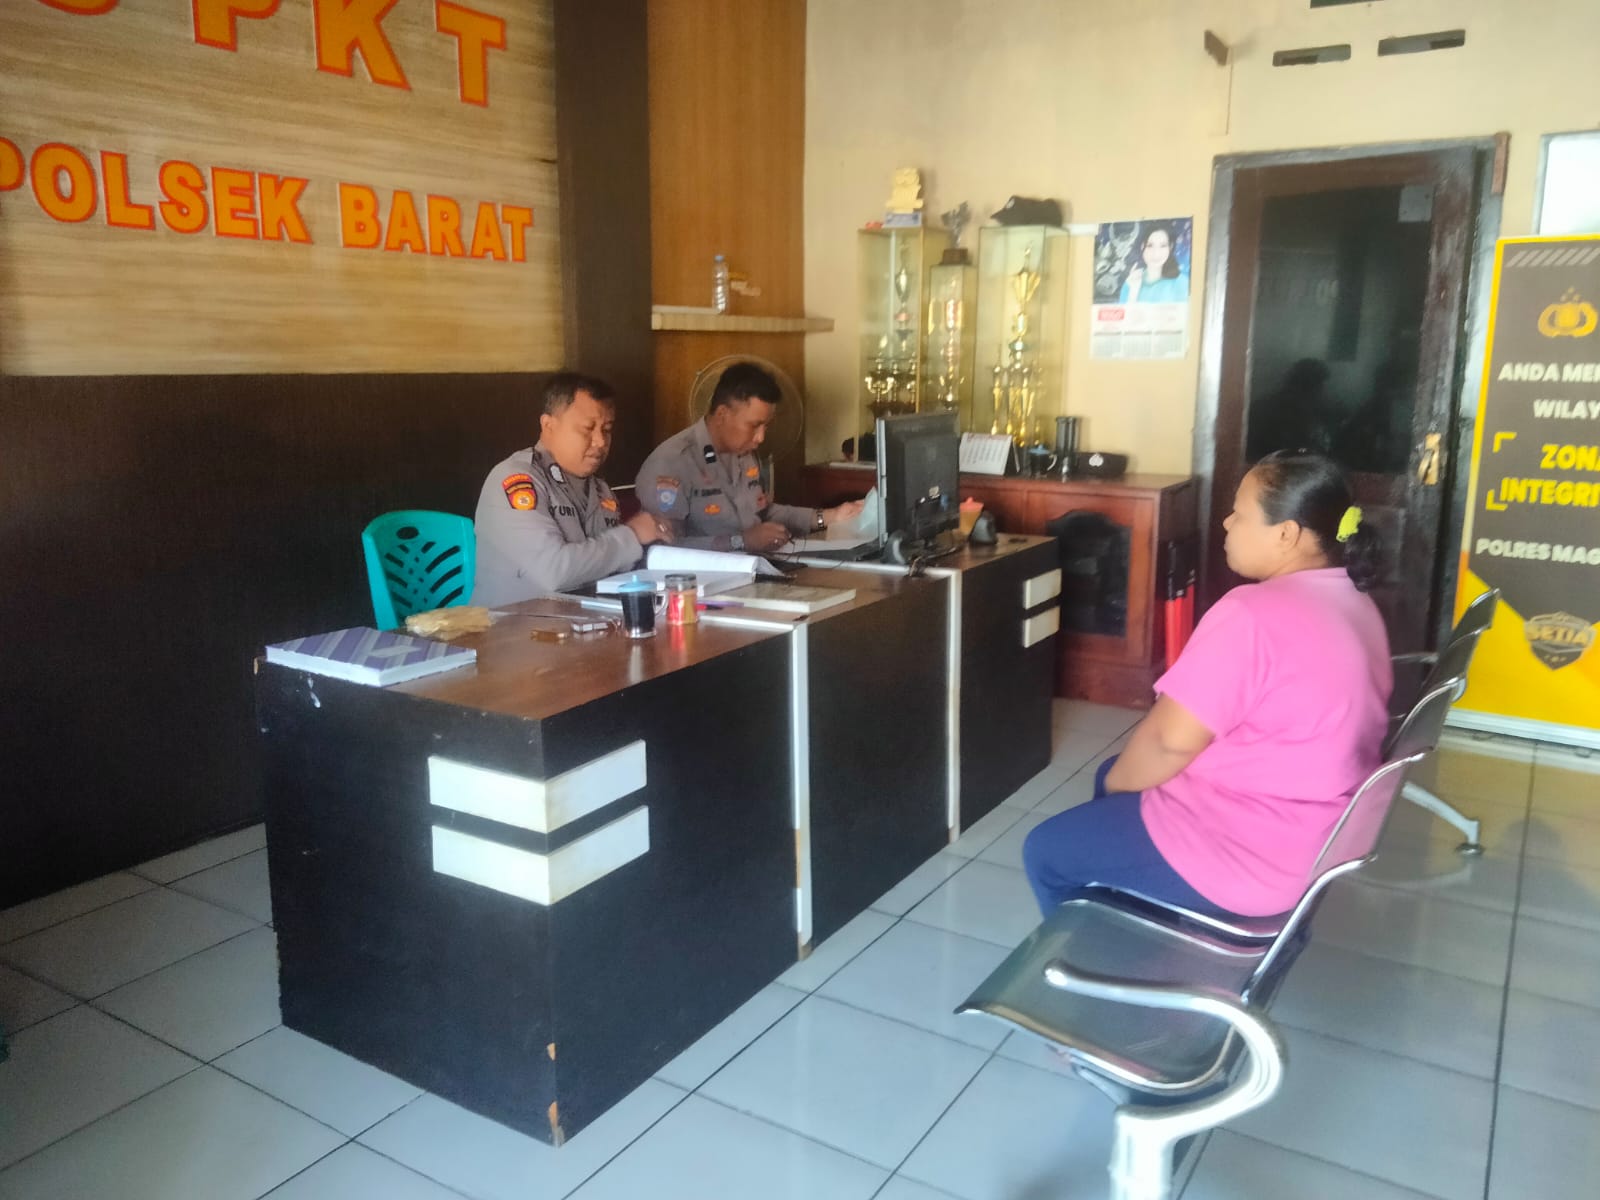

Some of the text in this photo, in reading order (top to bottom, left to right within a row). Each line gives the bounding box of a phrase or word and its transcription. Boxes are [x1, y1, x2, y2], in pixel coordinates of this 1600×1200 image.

[37, 0, 507, 107] PKT
[338, 181, 534, 262] BARAT
[1498, 362, 1560, 382] ANDA
[1540, 444, 1600, 471] ZON
[1500, 477, 1600, 507] INTEGRI
[1475, 538, 1550, 561] POLRES
